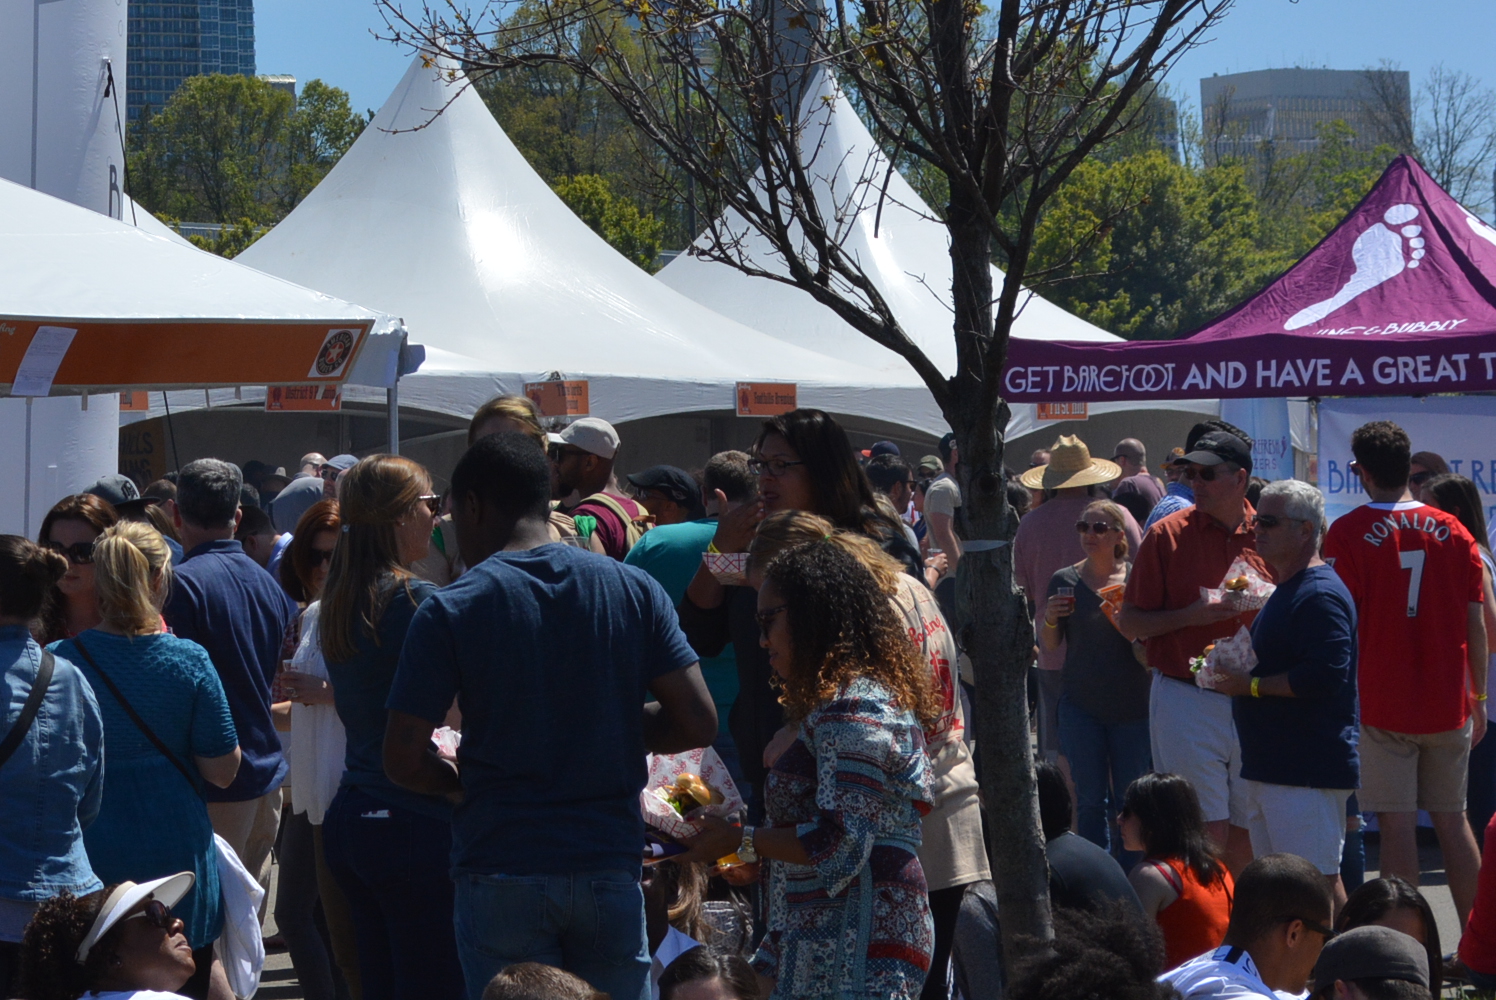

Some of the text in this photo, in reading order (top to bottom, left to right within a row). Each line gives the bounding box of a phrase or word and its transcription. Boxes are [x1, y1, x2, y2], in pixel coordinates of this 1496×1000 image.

[1380, 319, 1469, 336] BUBBLY
[1005, 366, 1060, 393] GET
[1061, 363, 1176, 393] BAREFOOT
[1181, 361, 1248, 390] AND
[1255, 358, 1333, 388] HAVE
[1339, 357, 1365, 385] A
[1372, 353, 1471, 385] GREAT
[1363, 512, 1451, 547] RONALDO
[1398, 549, 1426, 617] 7
